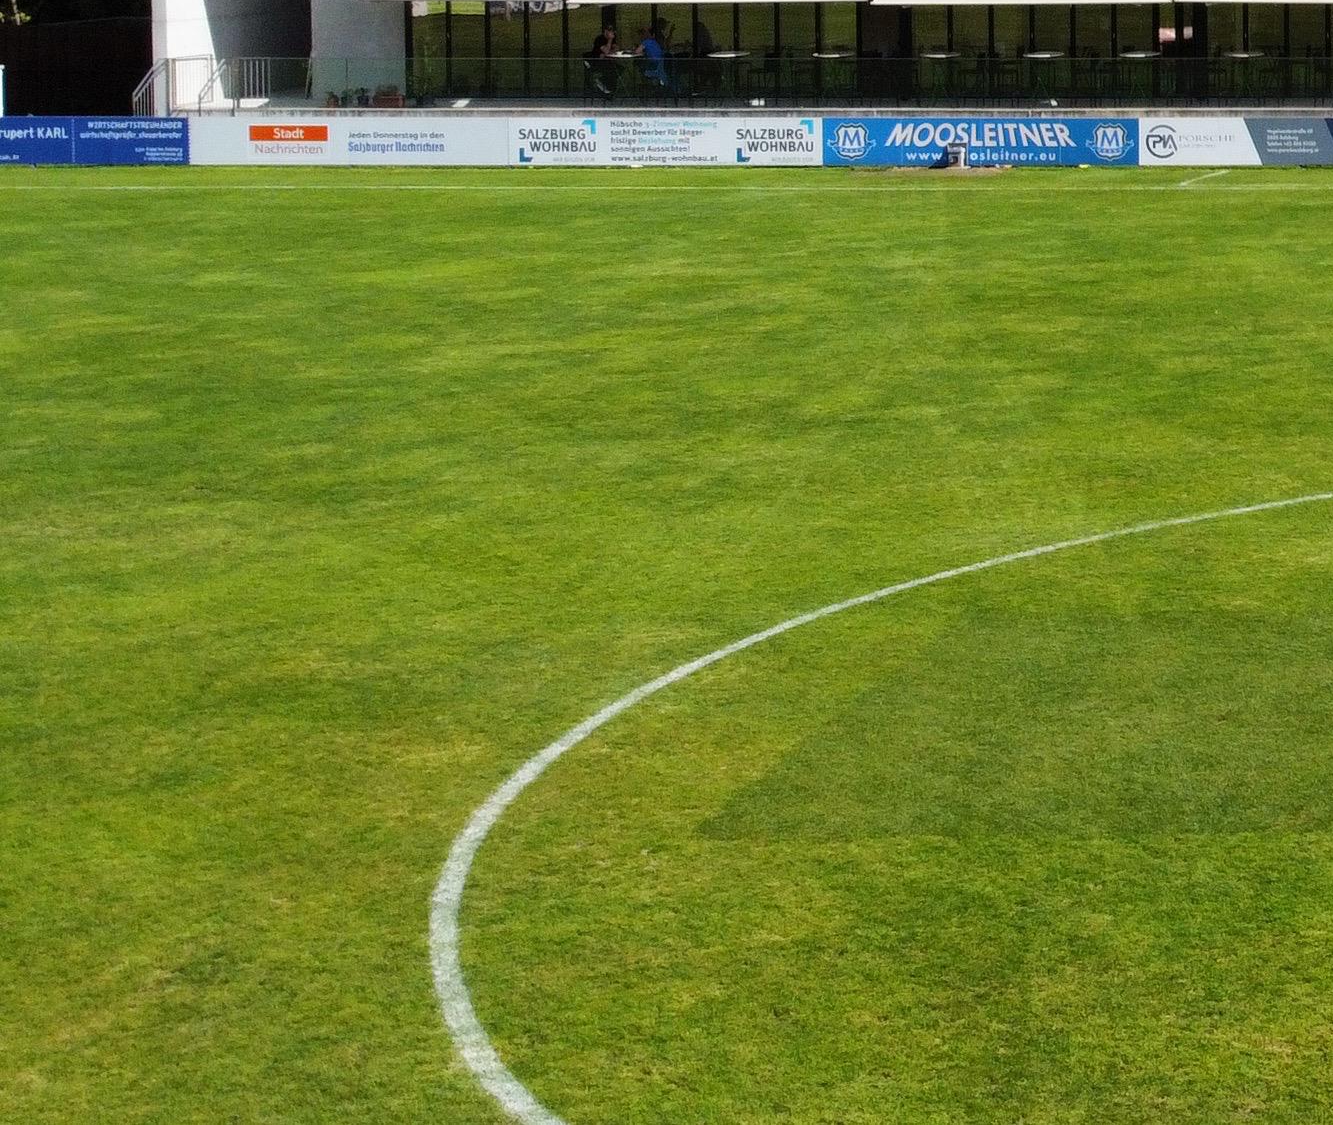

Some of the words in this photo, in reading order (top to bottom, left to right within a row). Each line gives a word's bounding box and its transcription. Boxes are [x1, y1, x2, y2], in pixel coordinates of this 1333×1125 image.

[37, 127, 69, 139] KARL
[273, 128, 305, 139] Stadt
[373, 132, 418, 140] Donnerstag
[518, 129, 586, 140] SALZBURG
[737, 129, 803, 140] SALZBURG
[842, 130, 862, 146] M
[885, 123, 1078, 147] MOOSLEITNER
[1100, 130, 1119, 146] M
[254, 143, 324, 154] Nachrichten
[529, 141, 597, 152] WOHNBAU
[747, 141, 814, 152] WOHNBAU
